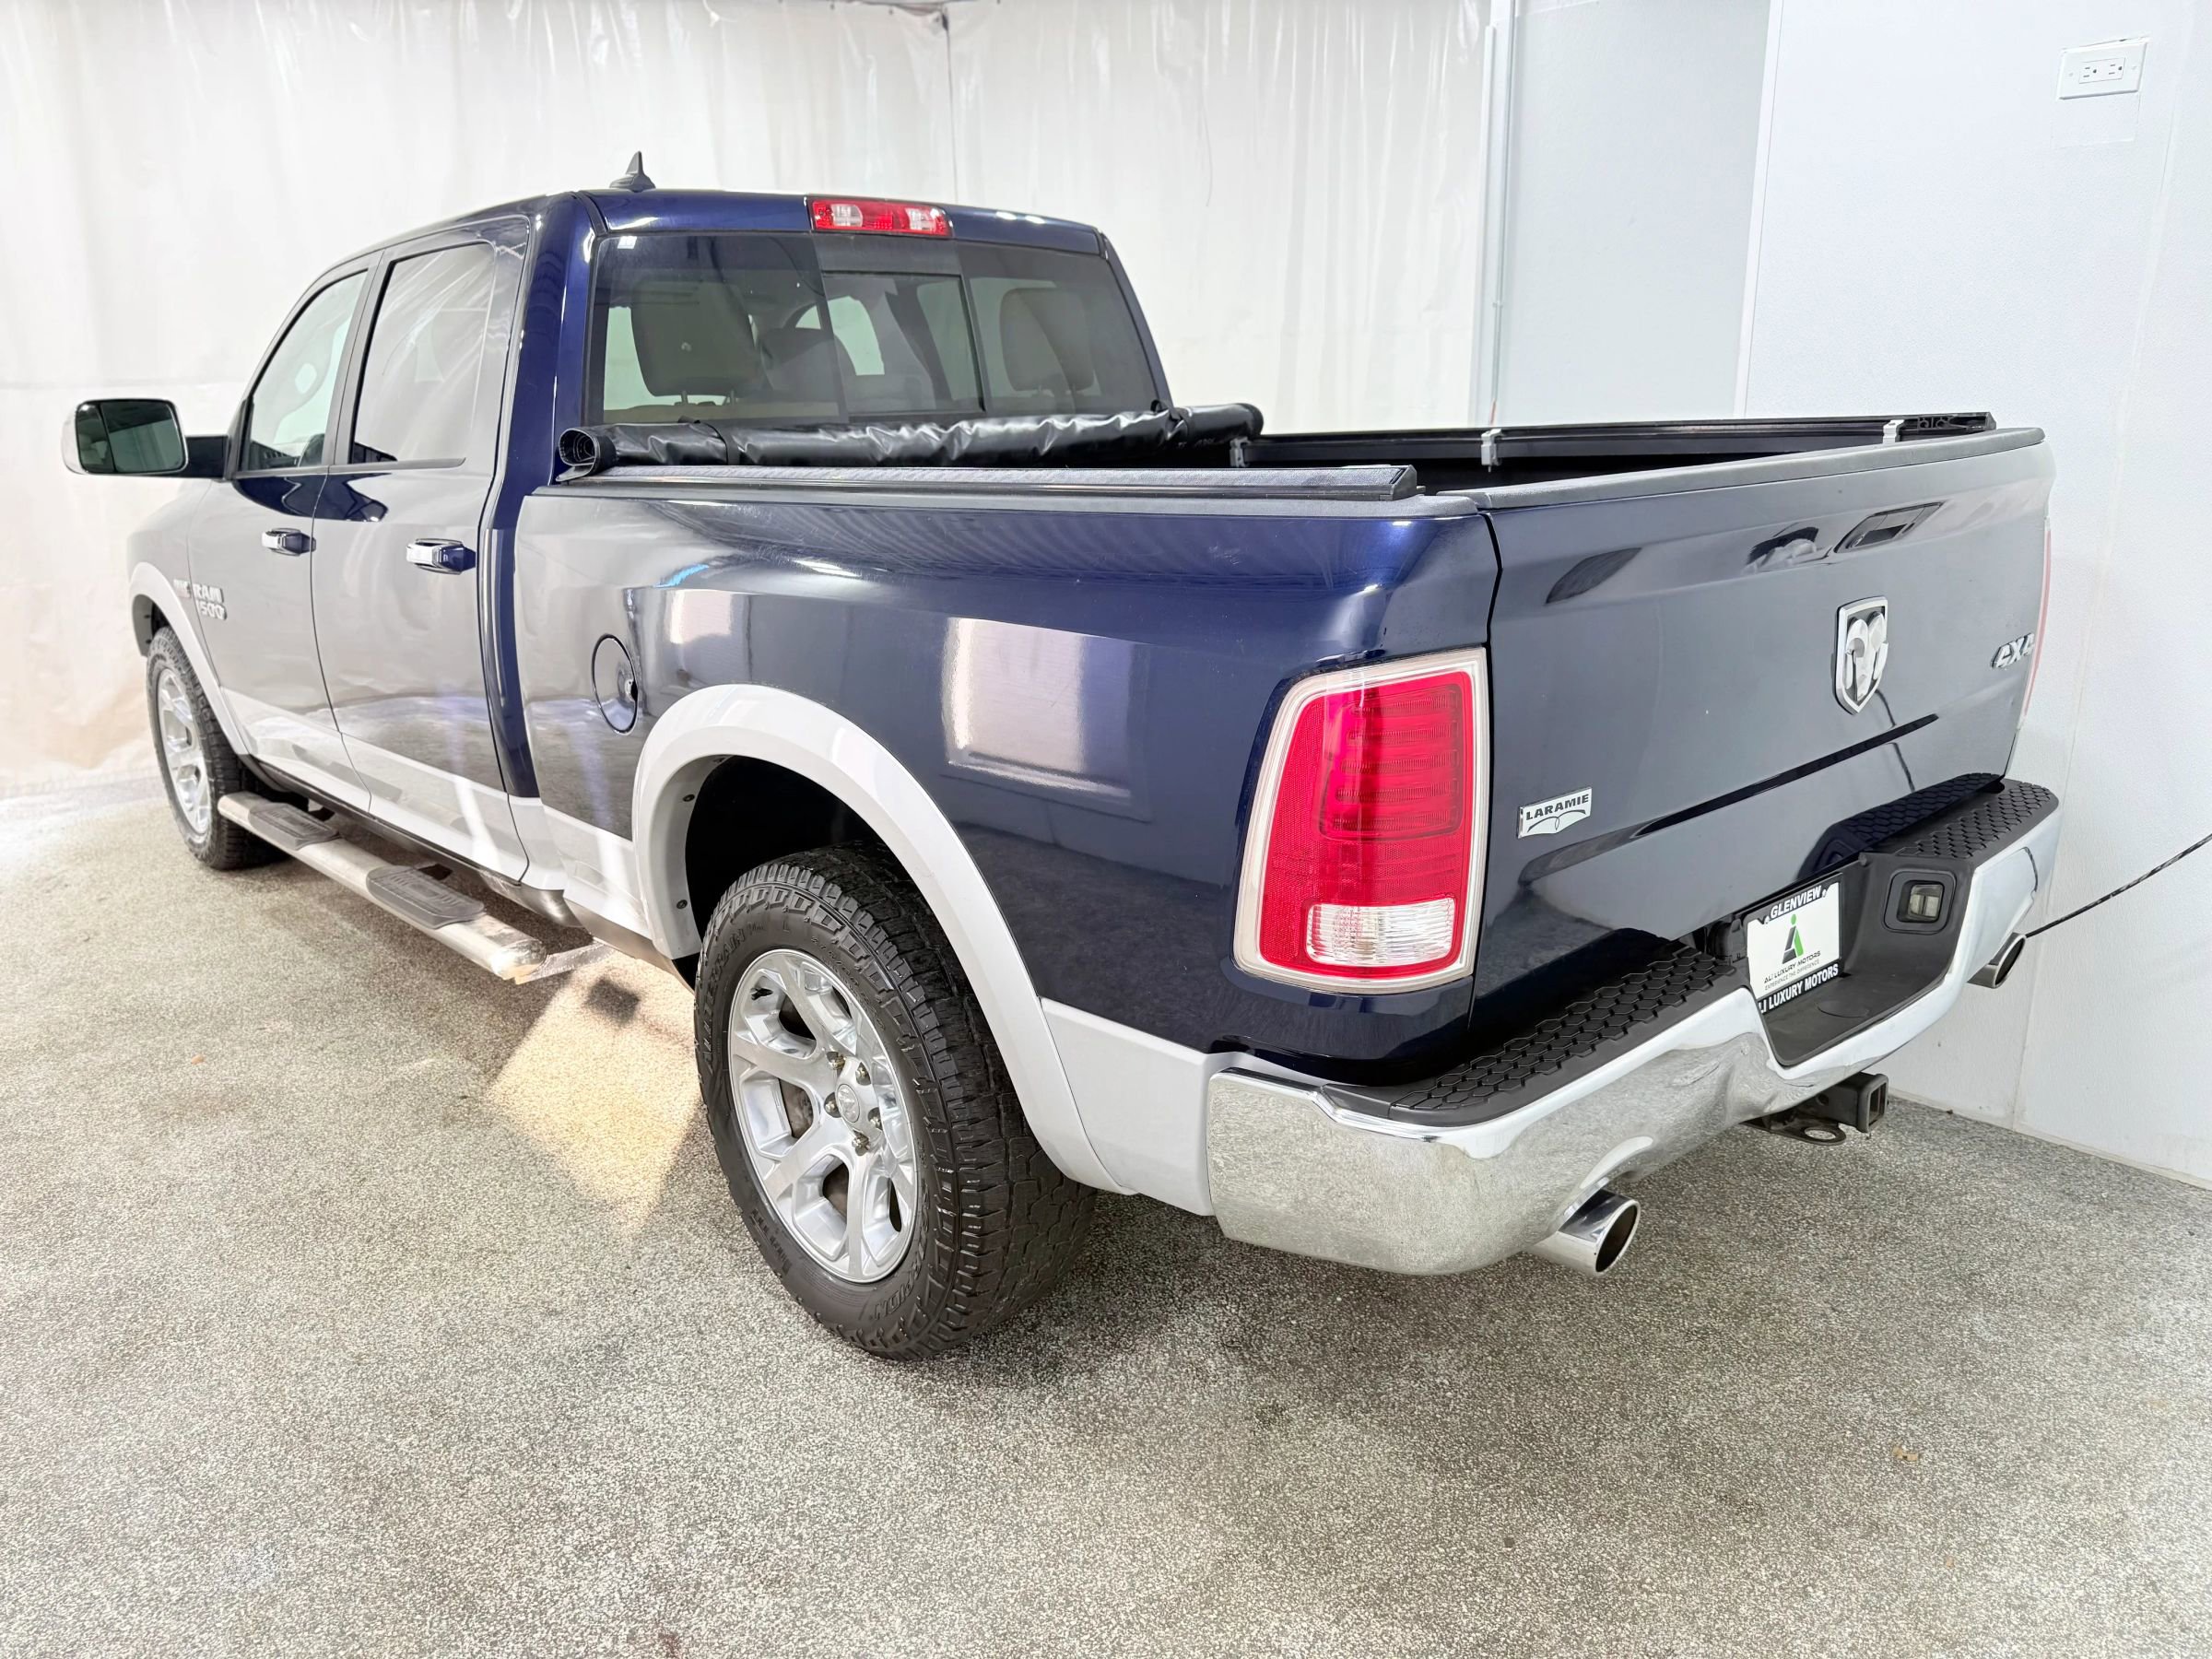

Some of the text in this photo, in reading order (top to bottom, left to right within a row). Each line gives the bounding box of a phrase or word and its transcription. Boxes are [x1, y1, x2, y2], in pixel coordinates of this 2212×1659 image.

[193, 582, 224, 604] RAM
[1526, 794, 1589, 821] LARAMIE
[1770, 885, 1822, 919] GLENVIEW
[1774, 962, 1796, 978] LUXURY
[1797, 950, 1821, 966] MOTORS
[1758, 963, 1839, 1014] LI LUXURY MOTORS
